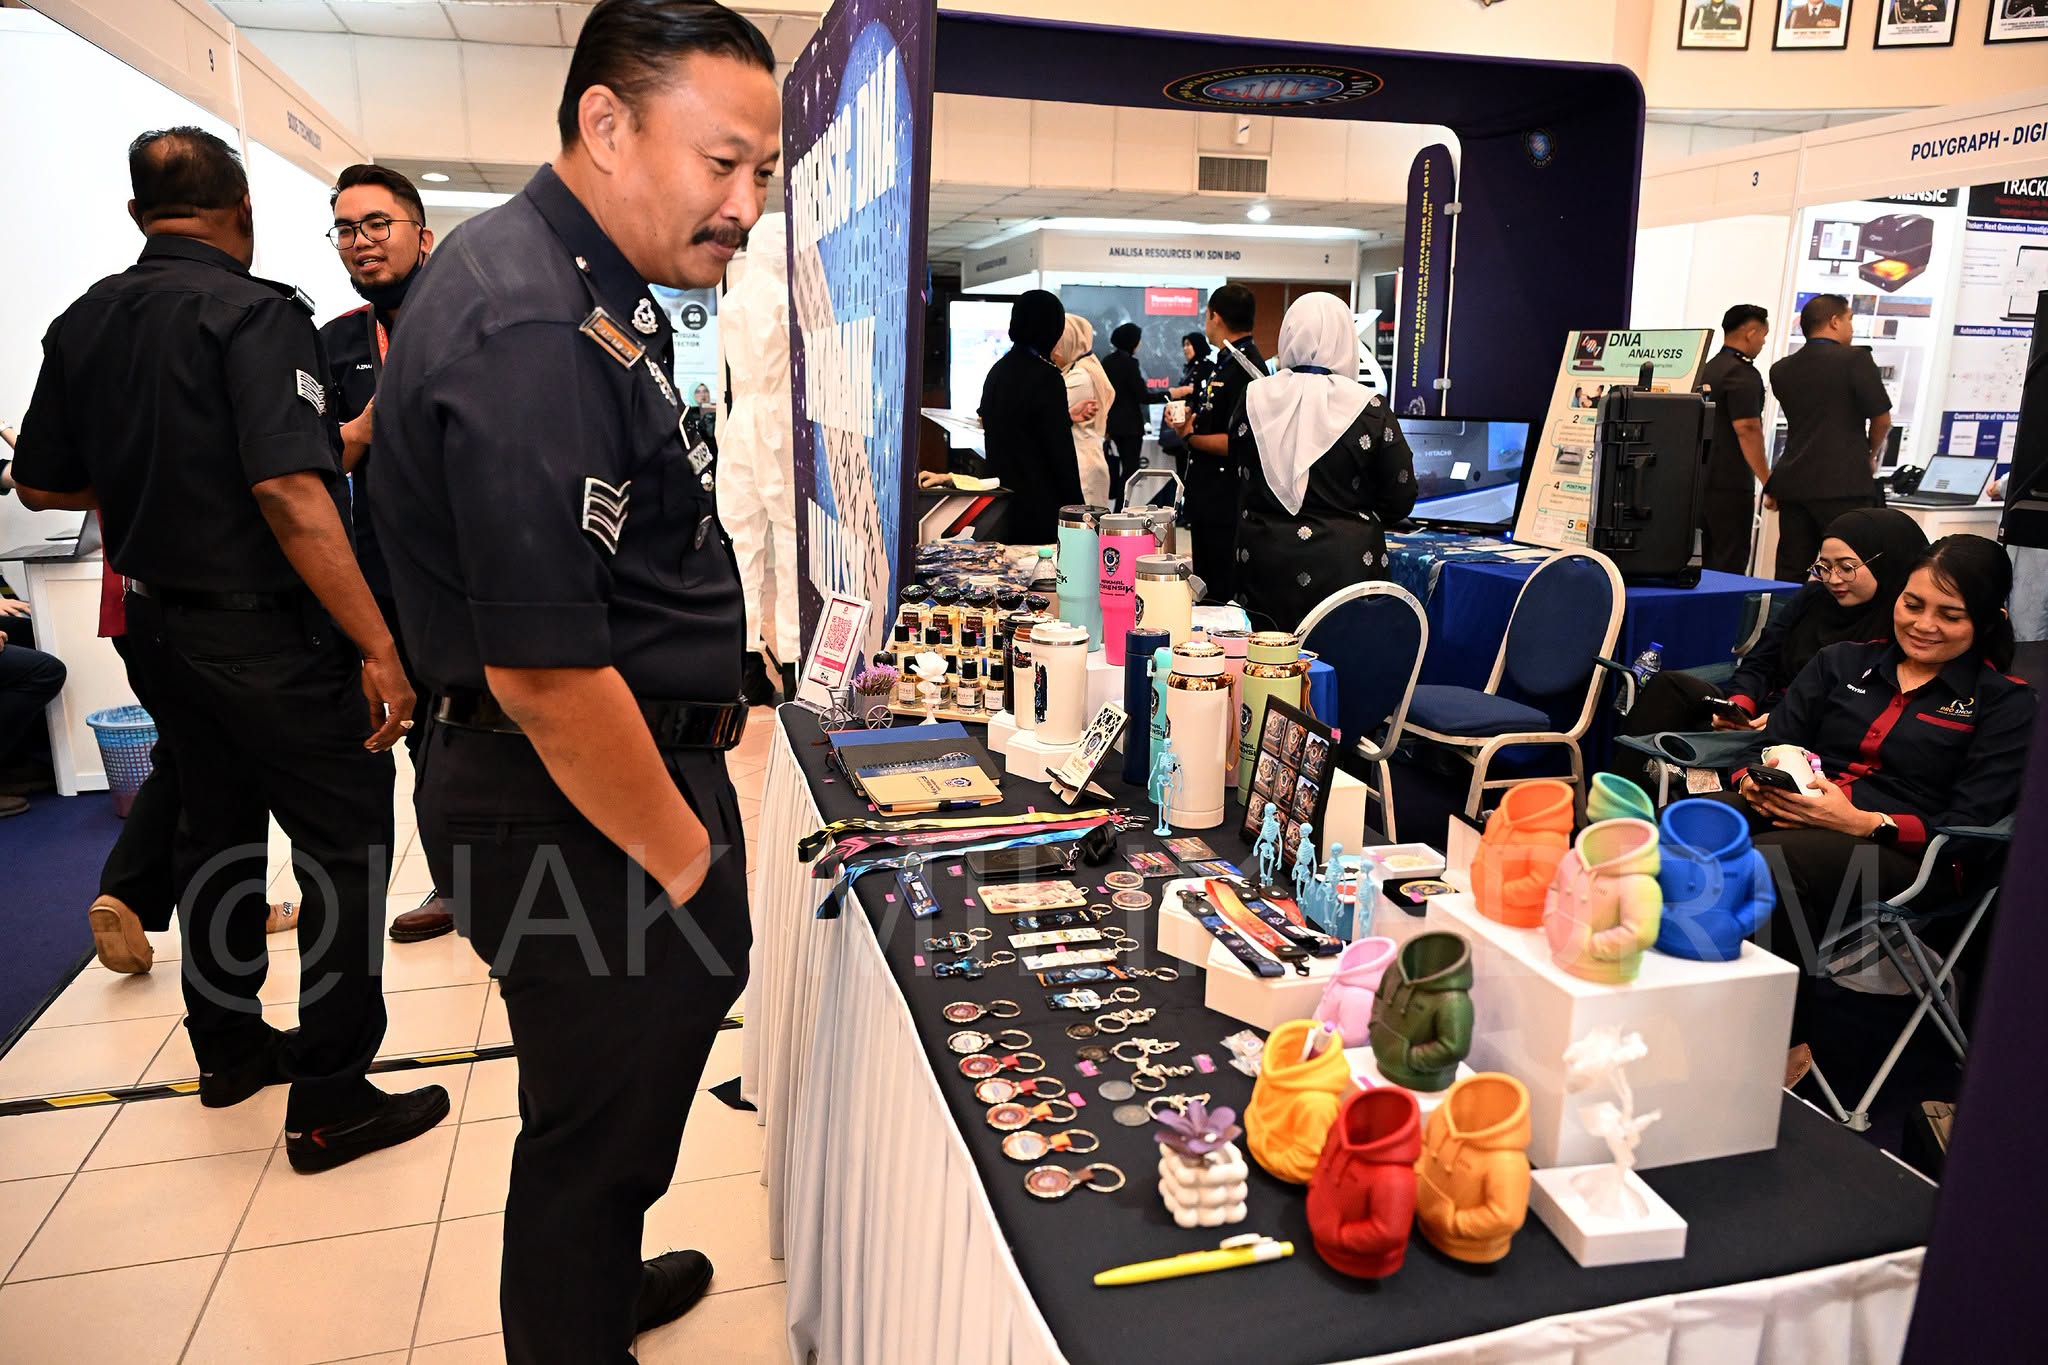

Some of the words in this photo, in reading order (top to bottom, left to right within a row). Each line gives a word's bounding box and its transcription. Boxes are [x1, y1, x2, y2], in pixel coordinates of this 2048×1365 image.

[791, 103, 852, 257] FORENSIC
[856, 45, 896, 213] DNA
[1911, 130, 2000, 160] POLYGRAPH
[1752, 171, 1759, 187] 3
[1424, 203, 1434, 247] JENAYAH
[1418, 216, 1428, 274] DATABANK
[1109, 247, 1144, 257] ANALISA
[1145, 248, 1191, 259] RESOURCES
[1193, 250, 1205, 259] (M)
[1207, 251, 1223, 260] SDN
[1225, 251, 1241, 261] BHD
[1422, 250, 1431, 297] SIASATAN
[1414, 277, 1424, 329] SIASATAN
[1419, 300, 1428, 344] JABATAN
[1608, 332, 1642, 347] DNA
[1411, 332, 1421, 388] BAHAGIAN
[1627, 348, 1684, 359] ANALYSIS
[1147, 376, 1169, 389] and
[1572, 414, 1580, 424] 2
[1587, 450, 1594, 460] 3
[1554, 481, 1561, 491] 4
[1567, 519, 1575, 529] 5
